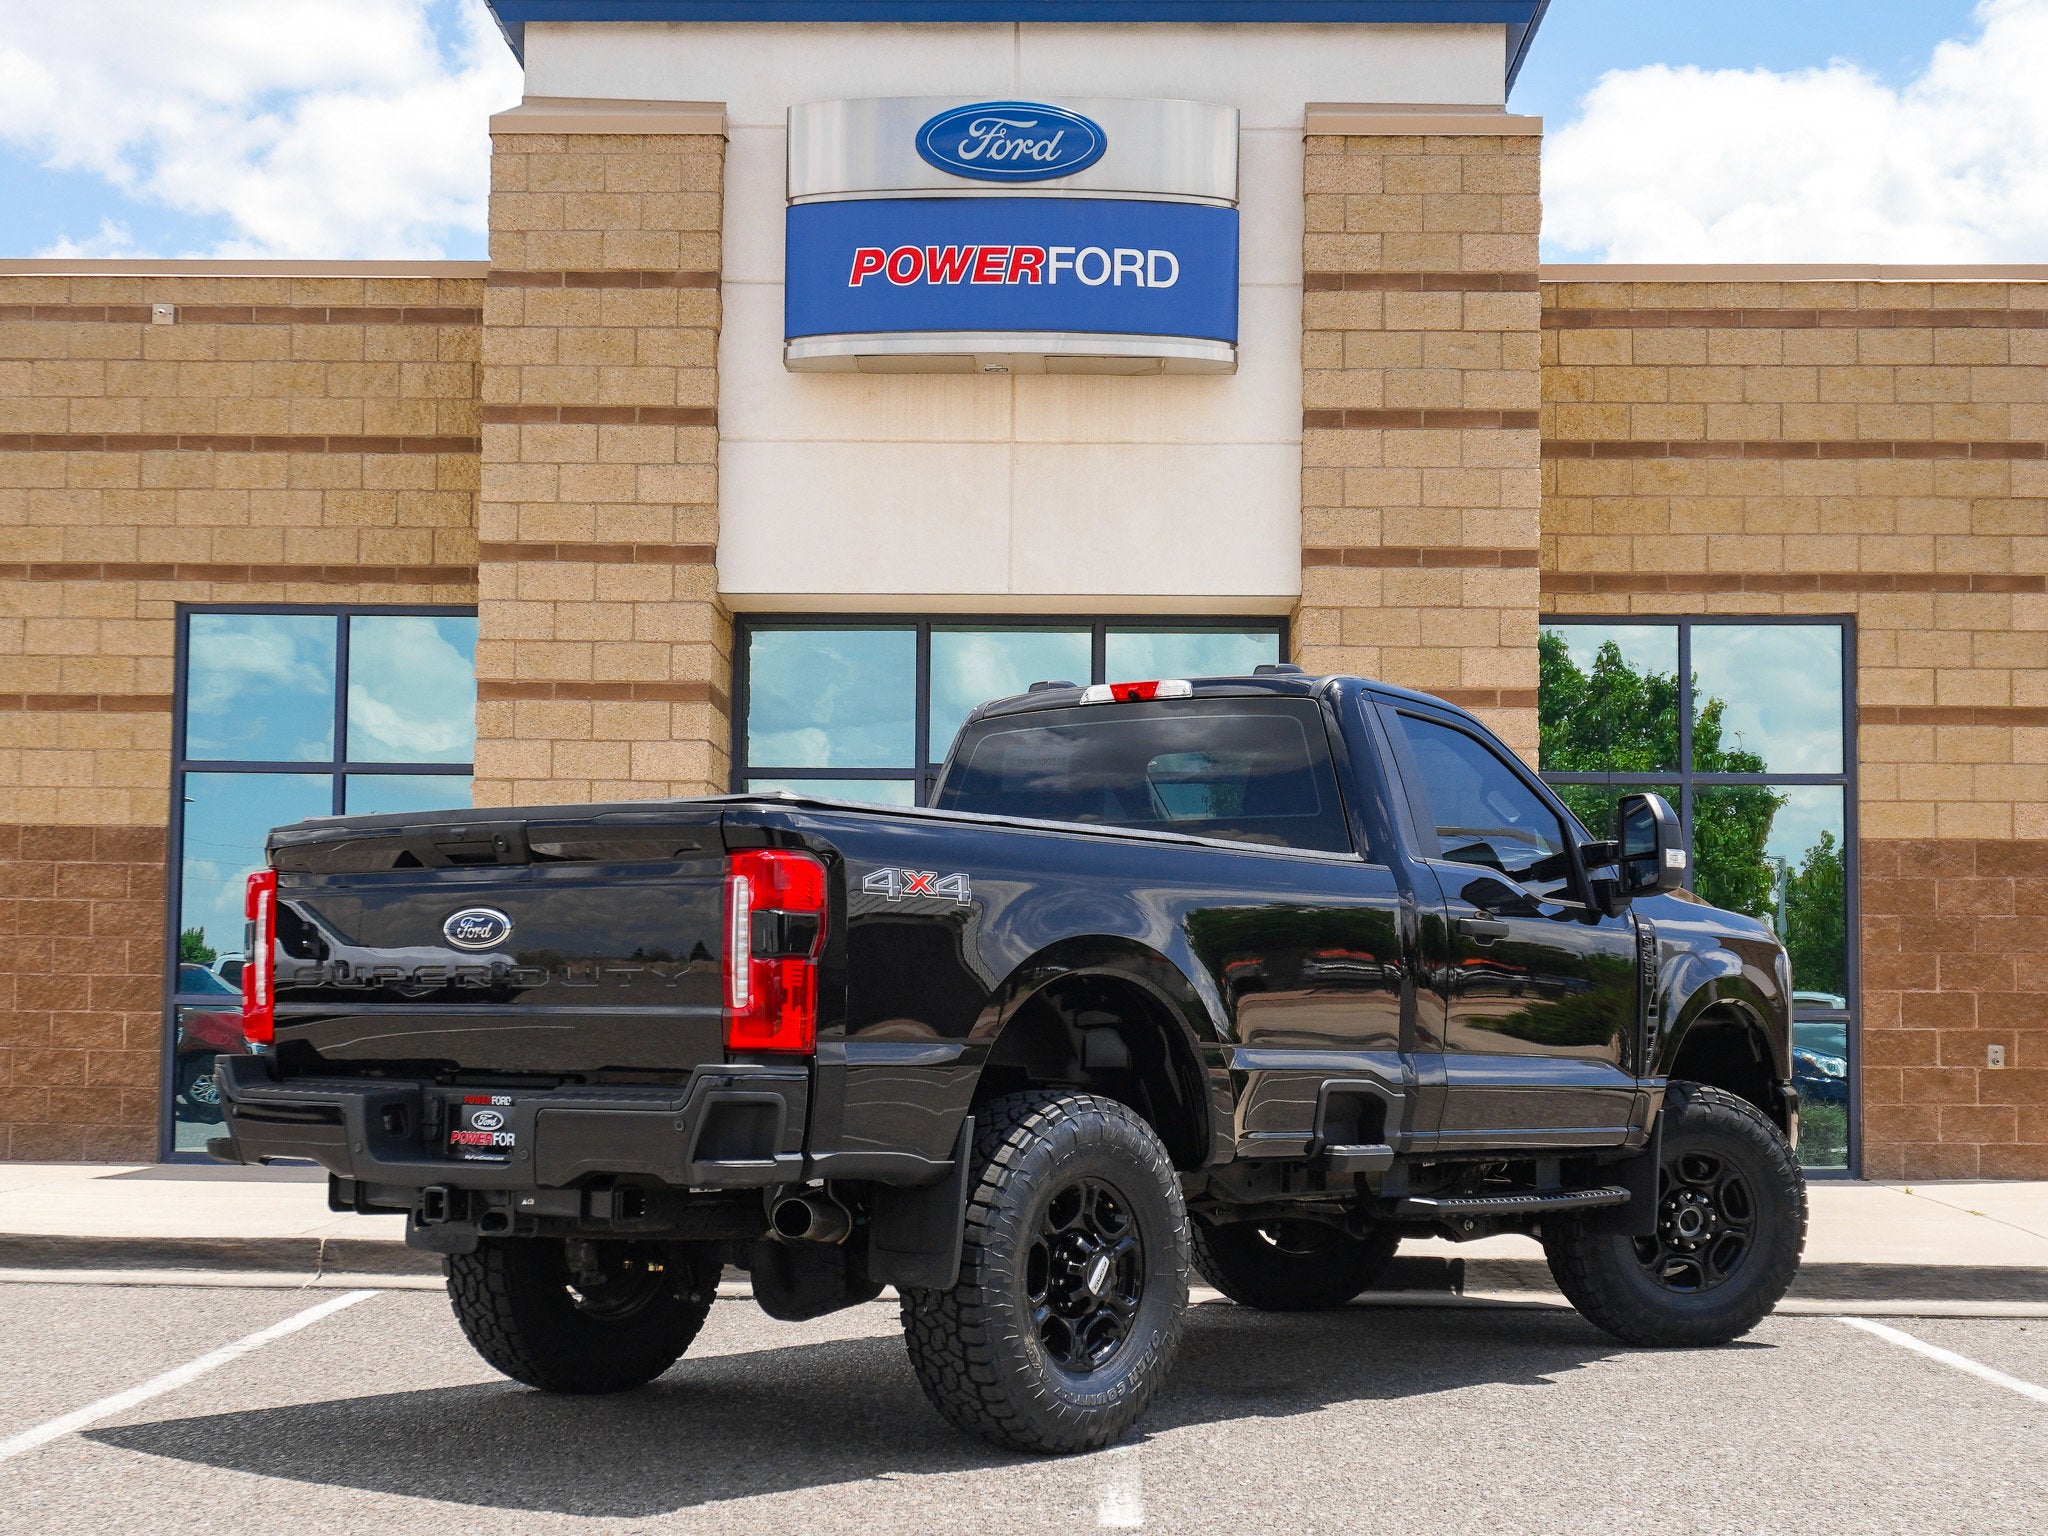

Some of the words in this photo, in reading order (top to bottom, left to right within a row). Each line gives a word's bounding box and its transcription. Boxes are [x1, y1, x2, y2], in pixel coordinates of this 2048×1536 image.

[957, 116, 1065, 162] Ford
[848, 244, 1180, 288] POWERFORD
[456, 916, 494, 939] Ford
[293, 964, 492, 988] SUPER
[504, 965, 691, 988] DUTY
[477, 1114, 498, 1127] Ford
[450, 1130, 516, 1147] POWERFOR
